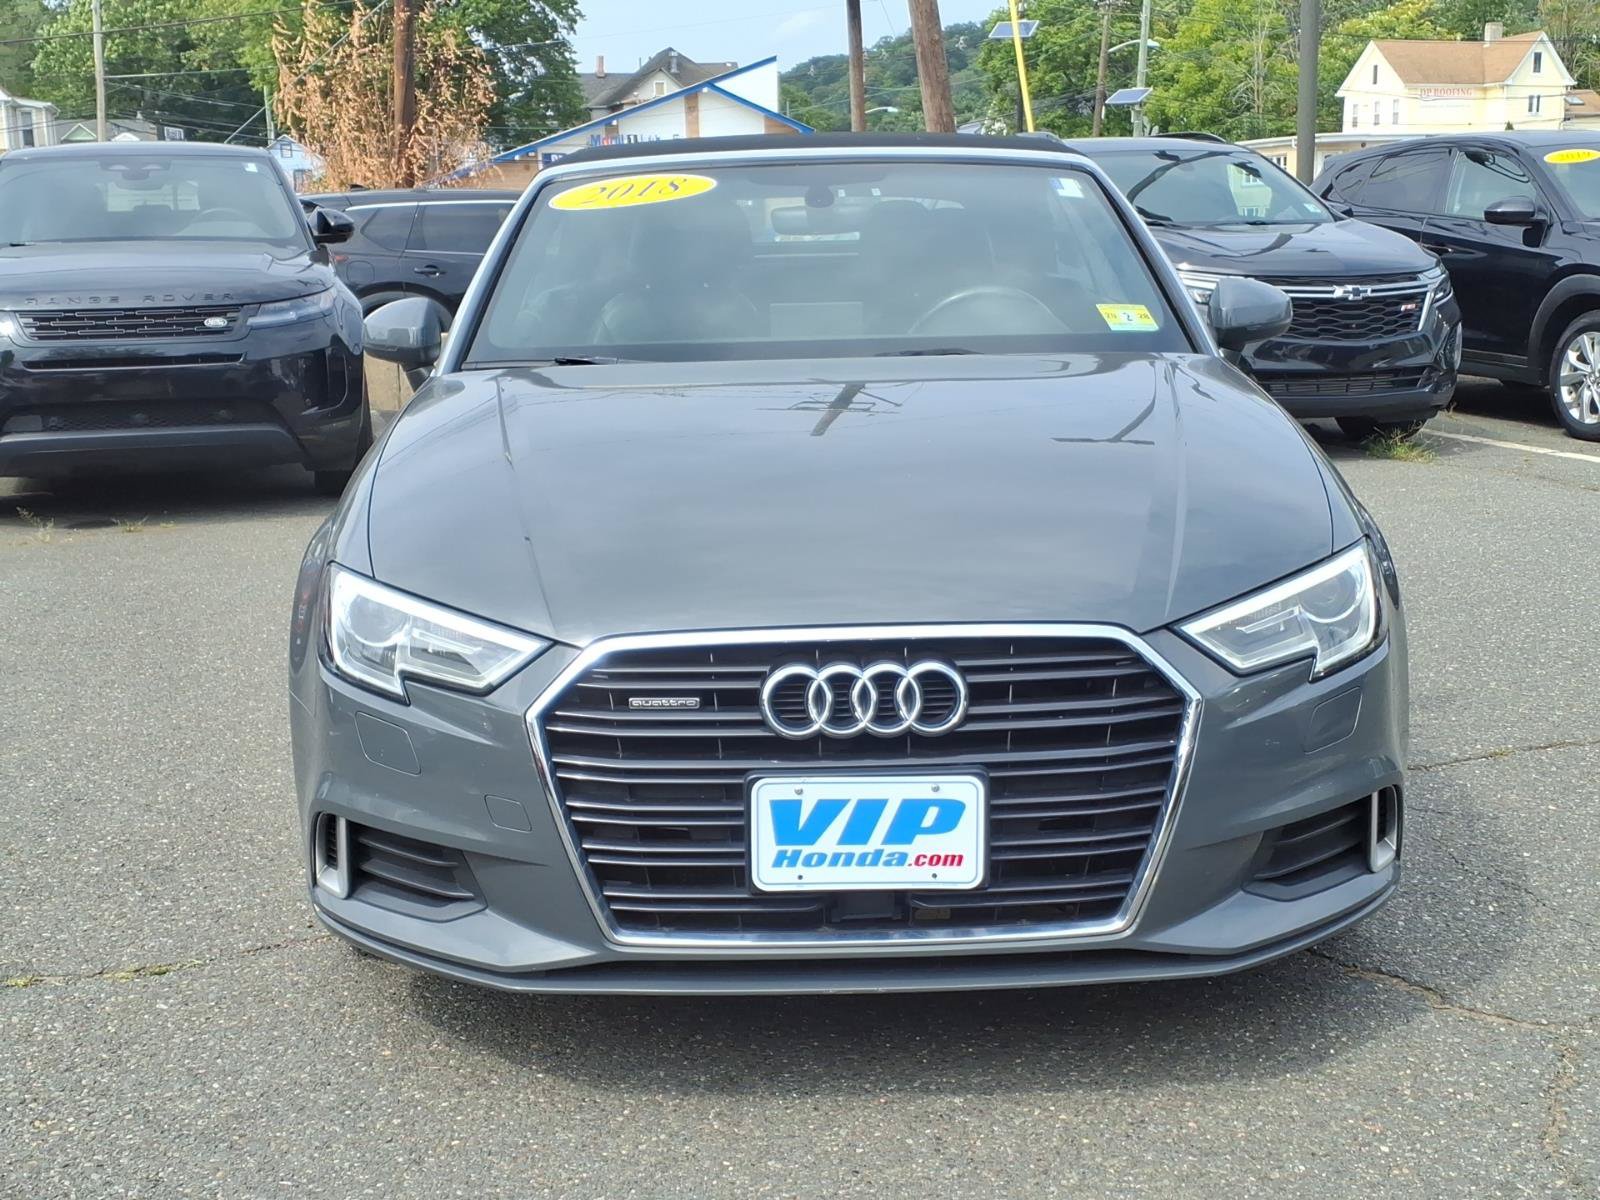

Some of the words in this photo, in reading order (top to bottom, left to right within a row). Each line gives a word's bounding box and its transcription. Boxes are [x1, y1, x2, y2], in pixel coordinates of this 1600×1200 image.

[578, 177, 688, 205] 2018
[24, 295, 121, 305] RANGE
[142, 292, 235, 303] ROVER
[630, 699, 697, 707] quattro
[768, 798, 967, 846] VIP
[771, 848, 965, 868] Honda.com
